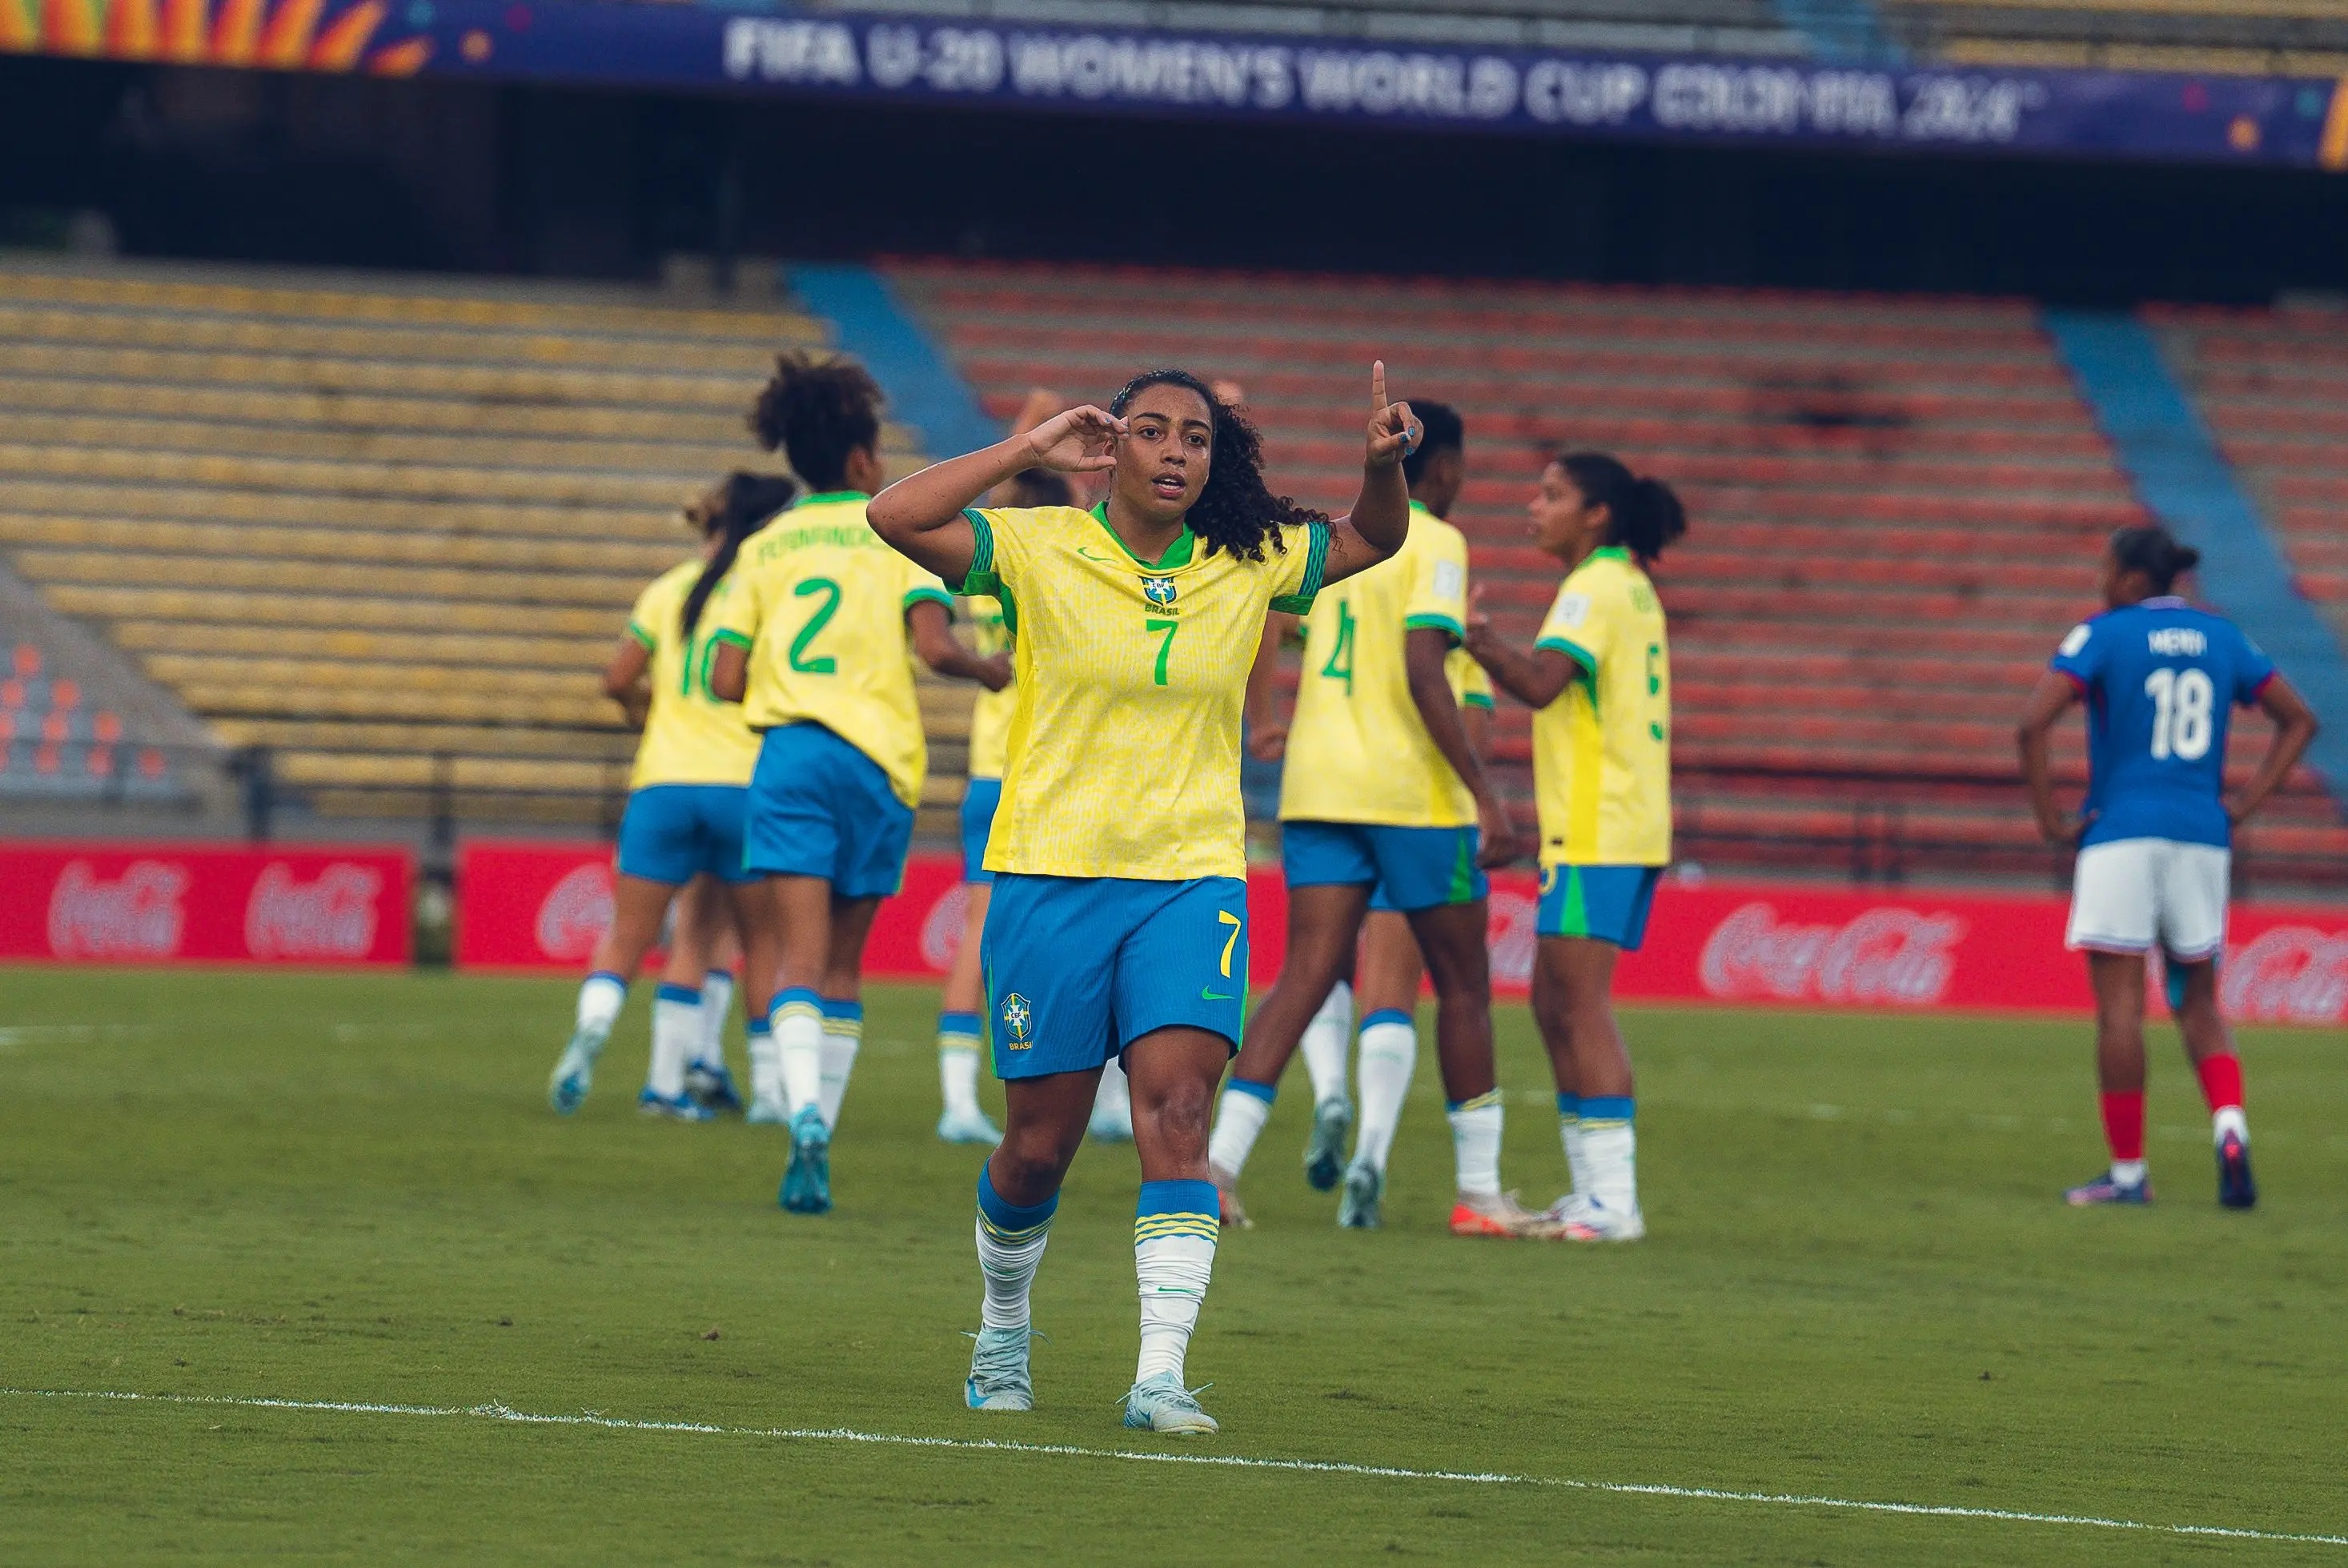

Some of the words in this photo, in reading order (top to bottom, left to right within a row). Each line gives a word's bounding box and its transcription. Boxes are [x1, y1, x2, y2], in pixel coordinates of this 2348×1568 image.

[723, 17, 861, 86] FIFA
[865, 23, 1004, 94] U-20
[1298, 50, 1519, 120] WORLD
[1523, 61, 1646, 124] CUP
[789, 577, 841, 674] 2
[1144, 603, 1180, 616] BRASIL
[1146, 619, 1179, 686] 7
[1321, 598, 1359, 699] 4
[2145, 666, 2214, 762] 18
[1218, 909, 1242, 979] 7
[1700, 901, 1968, 1003] Coca-Cola
[1009, 1041, 1034, 1050] BRASI
